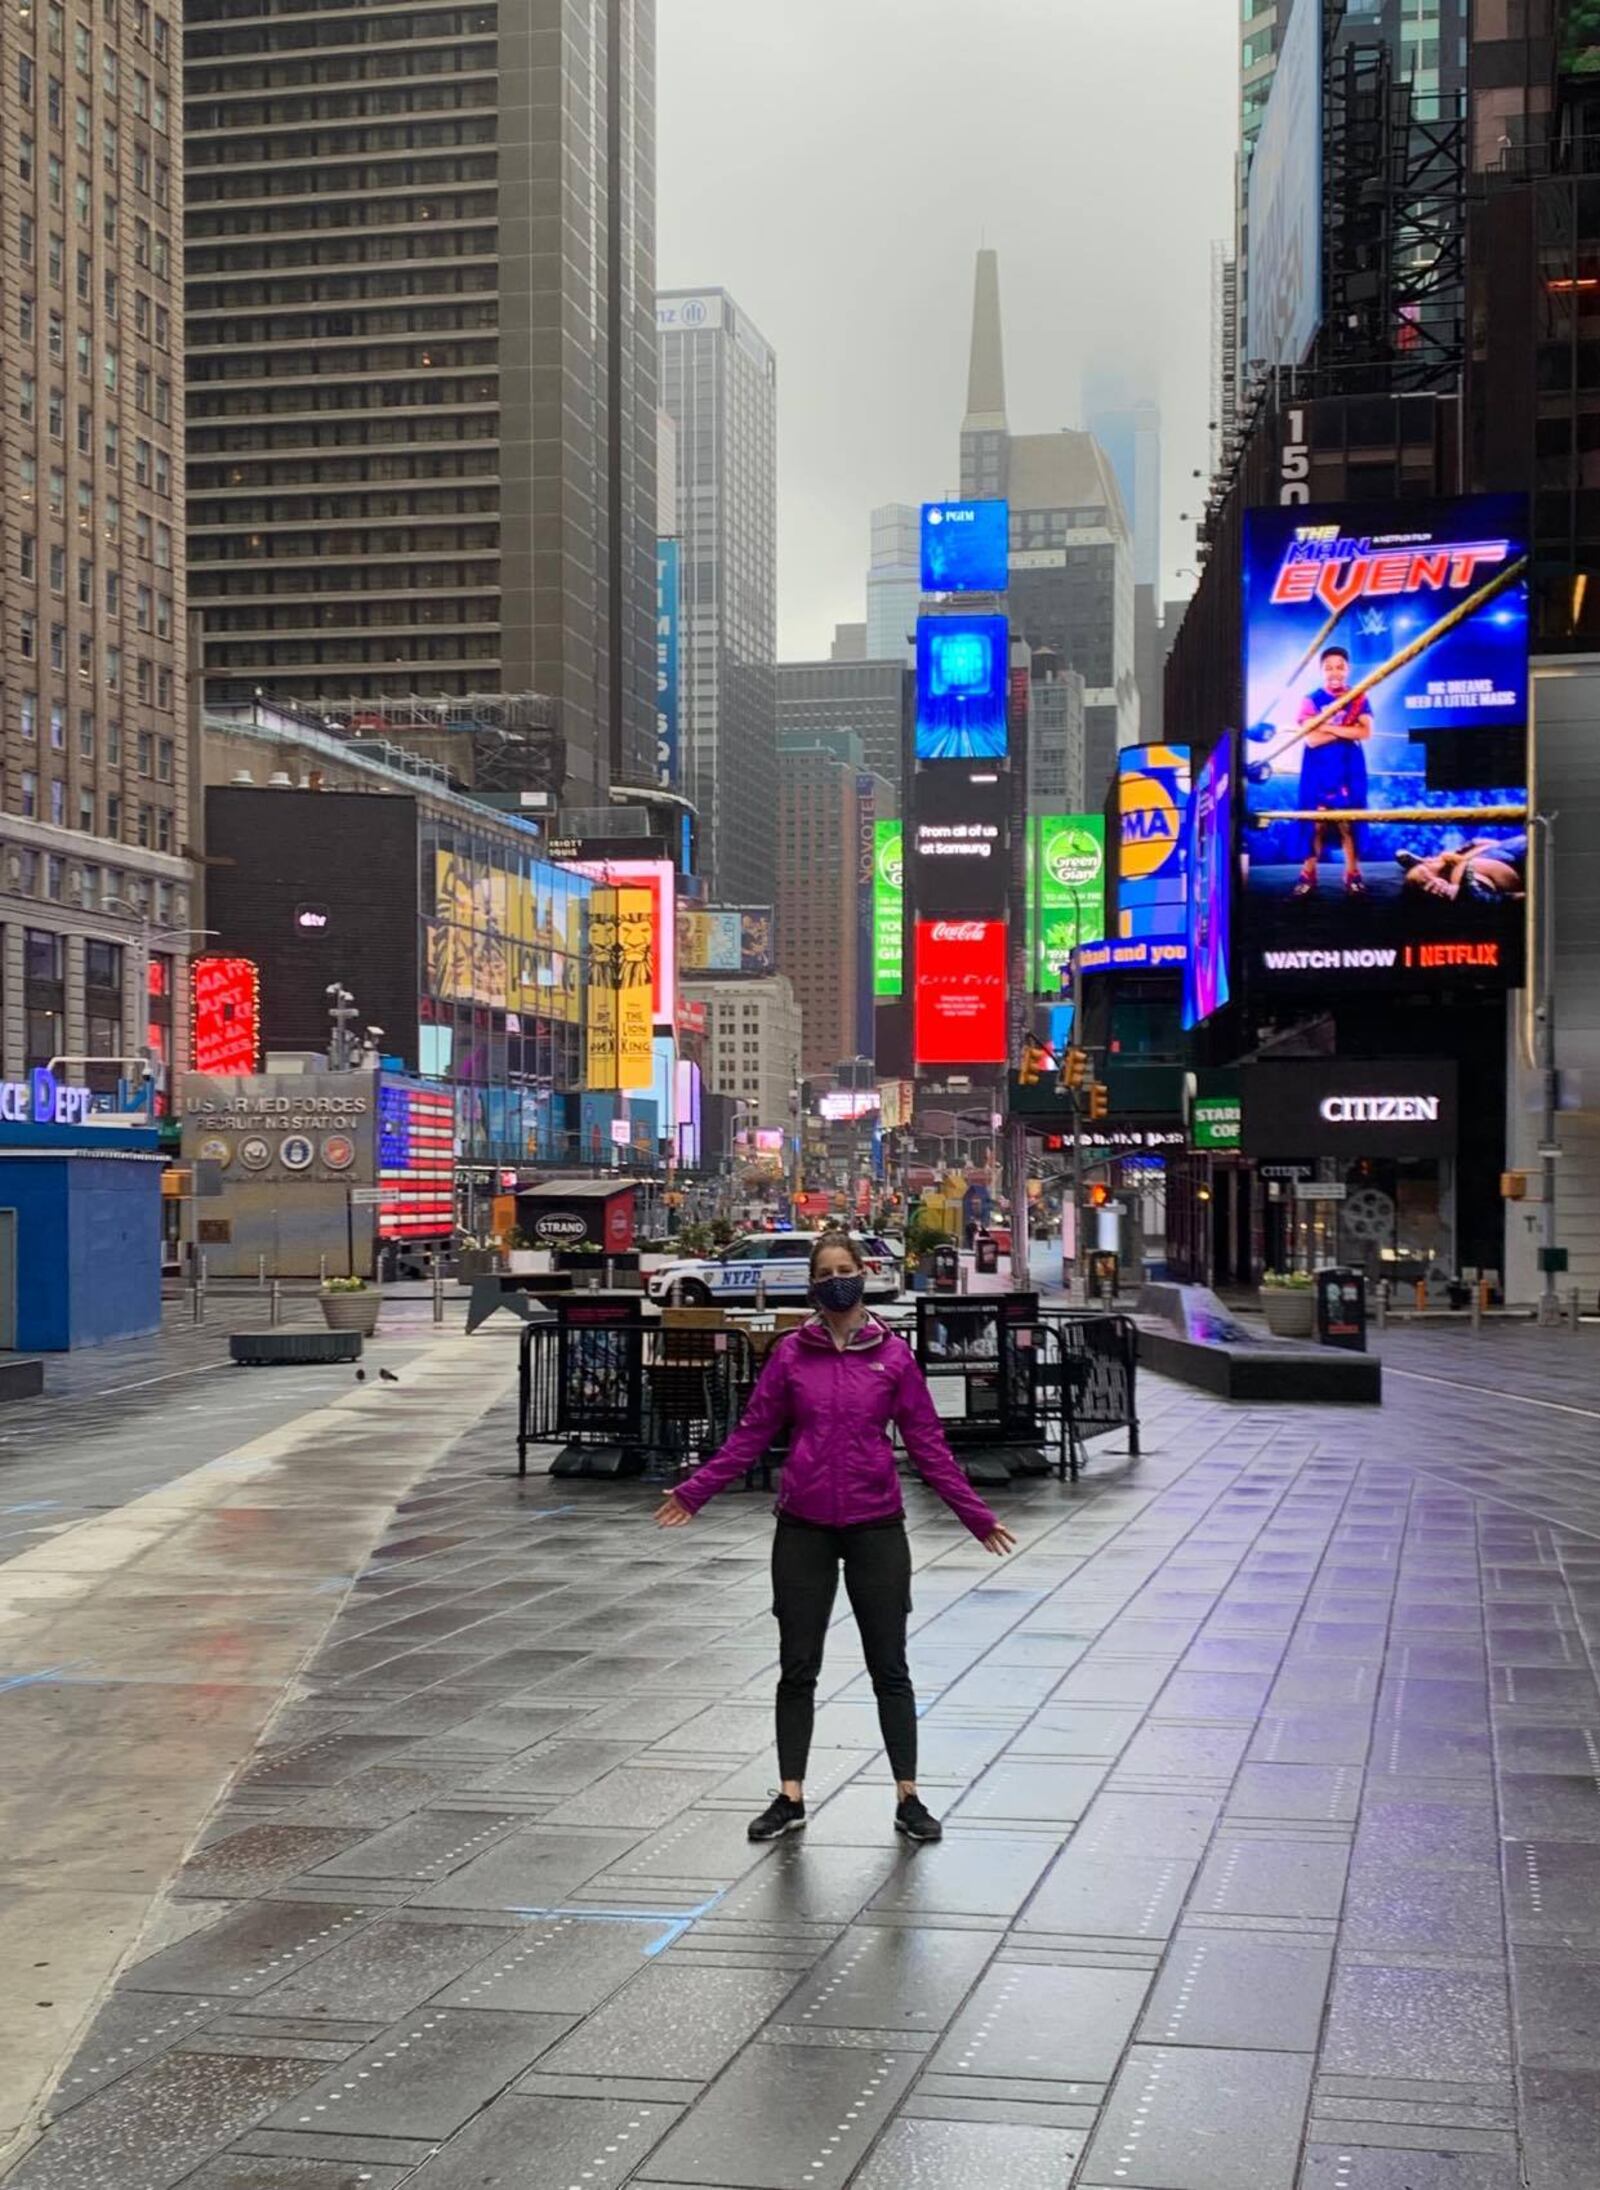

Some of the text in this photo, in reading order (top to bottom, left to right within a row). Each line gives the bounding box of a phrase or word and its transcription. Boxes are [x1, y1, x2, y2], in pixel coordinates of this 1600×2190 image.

[1296, 525, 1340, 541] THE
[1285, 537, 1370, 564] MAIN
[1270, 540, 1510, 615] EVENT
[1433, 695, 1443, 709] A
[1444, 693, 1479, 708] LITTLE
[859, 788, 875, 884] NOVOTEL
[919, 824, 998, 838] From all of us
[920, 842, 991, 857] at Samsung
[1053, 855, 1100, 868] Green
[1057, 867, 1098, 881] Giant
[1113, 944, 1147, 962] and
[1150, 946, 1187, 965] you
[1264, 944, 1498, 970] WATCH NOW NETFLIX
[620, 1038, 652, 1054] KING
[222, 1097, 290, 1114] ARMED
[294, 1096, 367, 1114] FORCES
[1320, 1096, 1440, 1122] CITIZEN
[197, 1115, 358, 1130] RECRUITING STATION
[1261, 1166, 1311, 1177] CITIZEN
[540, 1222, 584, 1233] STRAND
[722, 1270, 762, 1286] NYPD
